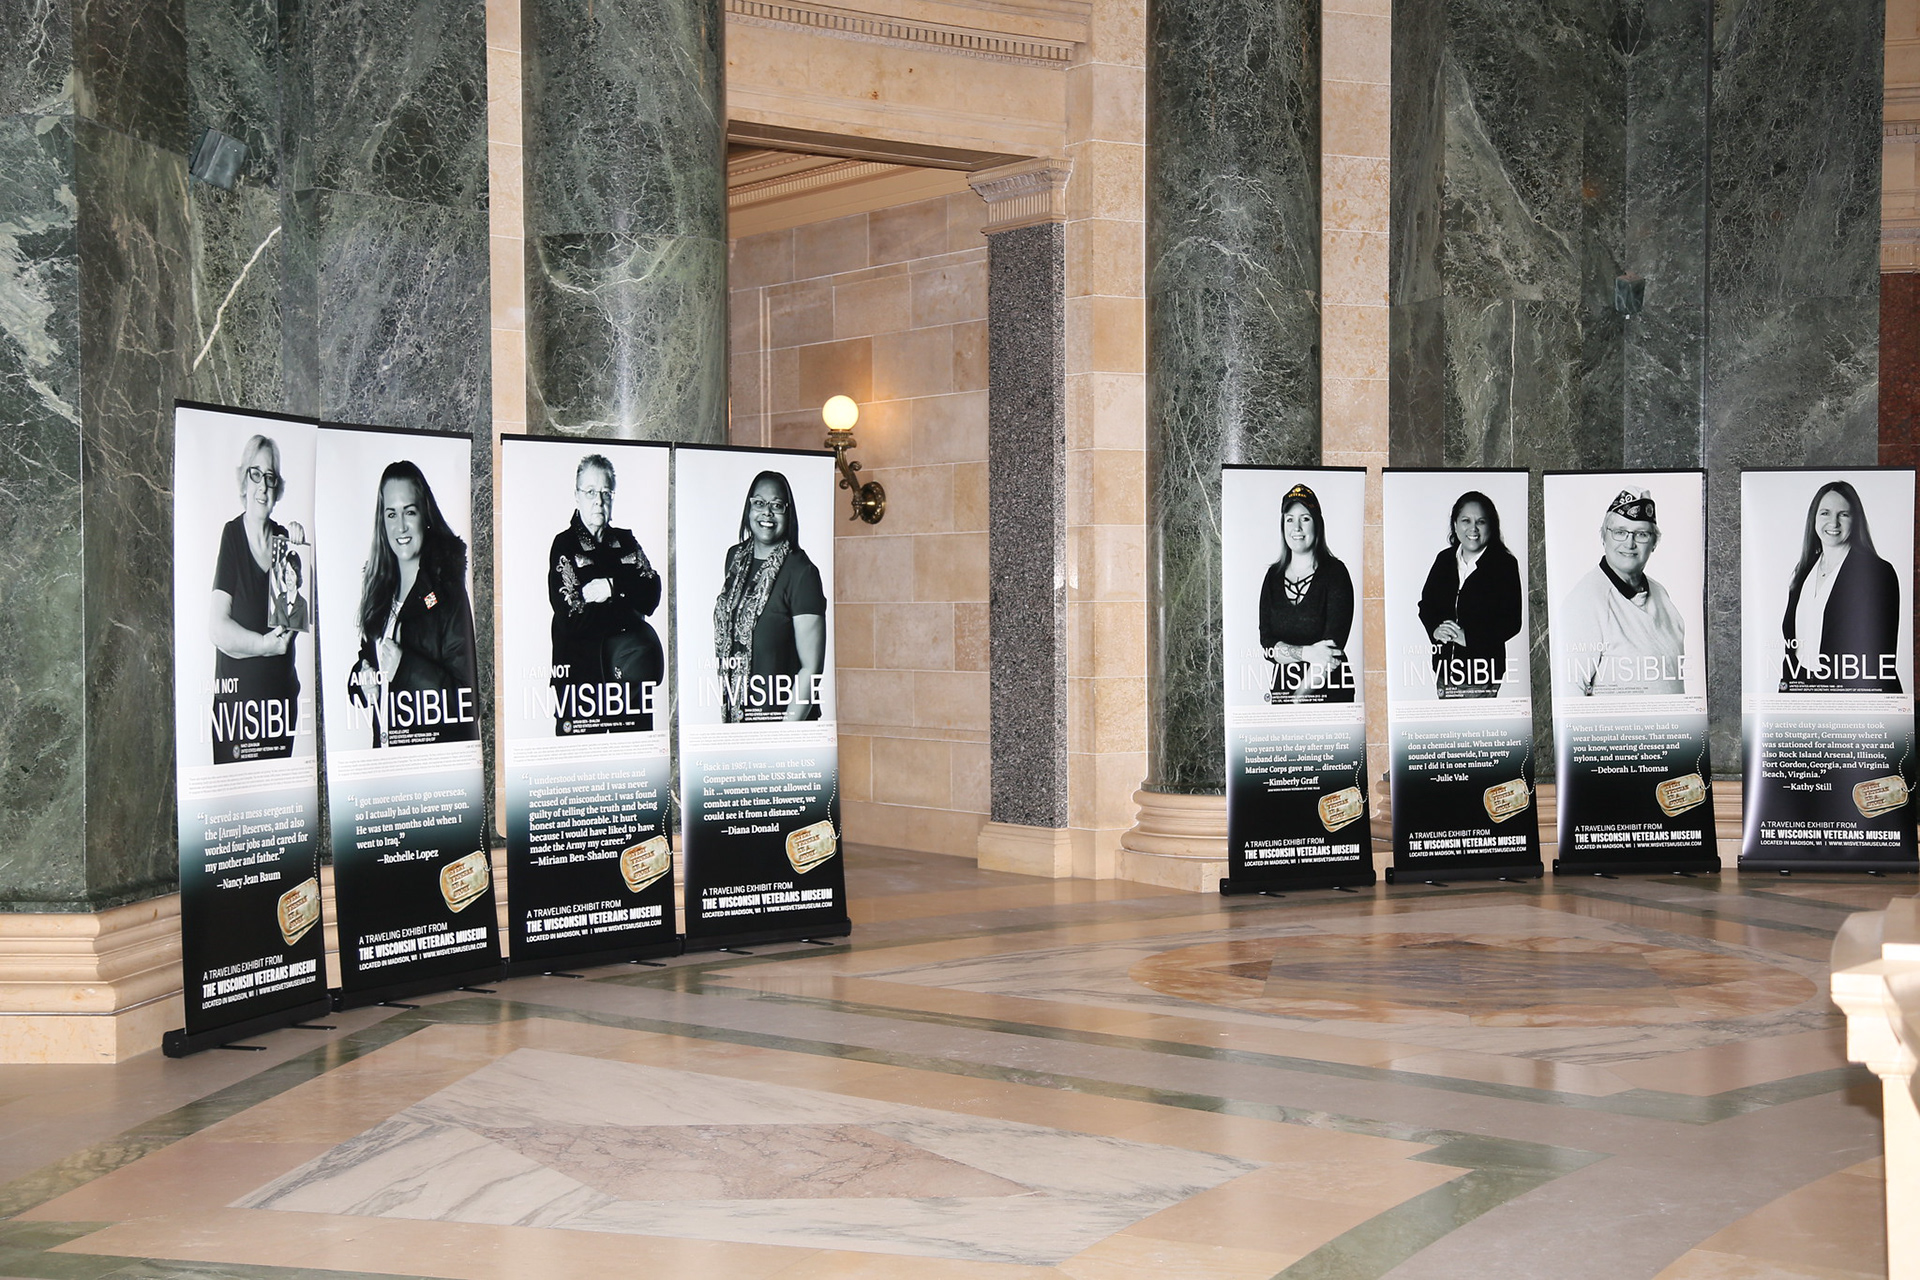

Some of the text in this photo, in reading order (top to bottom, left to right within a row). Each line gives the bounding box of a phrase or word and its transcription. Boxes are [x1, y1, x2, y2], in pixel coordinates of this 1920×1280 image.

[1408, 645, 1422, 655] AM
[1424, 644, 1442, 655] NOT
[1572, 642, 1587, 652] AM
[1590, 641, 1610, 652] NOT
[1783, 639, 1806, 649] NOT
[1246, 648, 1260, 658] AM
[1262, 647, 1280, 658] NOT
[704, 658, 719, 670] AM
[722, 657, 742, 669] NOT
[1567, 655, 1692, 682] INVISIBLE
[530, 666, 546, 678] AM
[549, 664, 570, 678] NOT
[1241, 662, 1355, 690] INVISIBLE
[1402, 658, 1519, 686] INVISIBLE
[351, 671, 388, 686] AM NOT
[222, 678, 240, 694] NOT
[698, 674, 826, 707] INVISIBLE
[522, 681, 657, 719] INVISIBLE
[346, 687, 474, 730] INVISIBLE
[199, 699, 312, 743] INVISIBLE
[1245, 755, 1273, 764] husband
[1273, 754, 1287, 762] died
[1296, 753, 1322, 763] Joining
[1408, 752, 1436, 760] sounded
[1436, 751, 1446, 759] off
[1446, 750, 1478, 759] basewide,
[1490, 750, 1510, 759] pretty
[1574, 752, 1600, 764] nylons,
[1600, 753, 1614, 761] and
[1778, 750, 1798, 758] Rock
[1823, 751, 1856, 760] Arsenal,
[1857, 751, 1887, 760] Illinois,
[1638, 764, 1669, 773] Thomas
[1762, 770, 1787, 779] Beach,
[1300, 776, 1319, 785] Graff
[1453, 773, 1469, 781] Vale
[1815, 783, 1832, 791] Still
[703, 811, 725, 821] could
[738, 810, 744, 819] it
[745, 809, 763, 819] from
[751, 822, 780, 834] Donald
[1414, 830, 1447, 839] TRAVELING
[1448, 829, 1472, 838] EXHIBIT
[1760, 829, 1901, 840] THE WISCONSIN VETERANS MUSEUM
[1250, 839, 1282, 848] TRAVELING
[1283, 838, 1306, 846] EXHIBIT
[1409, 835, 1526, 851] THE WISCONSIN VETERANS MUSEUM
[1574, 830, 1702, 843] THE WISCONSIN VETERANS MUSEUM
[356, 839, 376, 849] went
[376, 839, 384, 847] to
[530, 843, 552, 854] made
[552, 842, 565, 852] the
[566, 841, 587, 851] Army
[587, 840, 600, 849] my
[416, 849, 439, 860] Lopez
[569, 849, 618, 863] Ben-Shalom
[1244, 844, 1360, 860] THE WISCONSIN VETERANS MUSEUM
[205, 862, 218, 874] my
[218, 856, 242, 871] mother
[242, 853, 256, 866] and
[243, 874, 259, 886] Jean
[260, 871, 281, 883] Baum
[709, 885, 745, 896] TRAVELING
[746, 883, 772, 893] EXHIBIT
[773, 881, 793, 890] FROM
[702, 888, 833, 910] THE WISCONSIN VETERANS MUSEUM
[526, 899, 622, 919] A TRAVELING EXHIBIT FROM
[526, 905, 662, 933] THE WISCONSIN VETERANS MUSEUM
[365, 929, 401, 944] TRAVELING
[401, 925, 427, 938] EXHIBIT
[428, 922, 448, 933] FROM
[358, 926, 487, 961] THE WISCONSIN VETERANS MUSEUM
[209, 963, 241, 980] TRAVELING
[241, 958, 264, 972] EXHIBIT
[265, 954, 283, 966] FROM
[202, 958, 316, 999] THE WISCONSIN VETERANS MUSEUM
